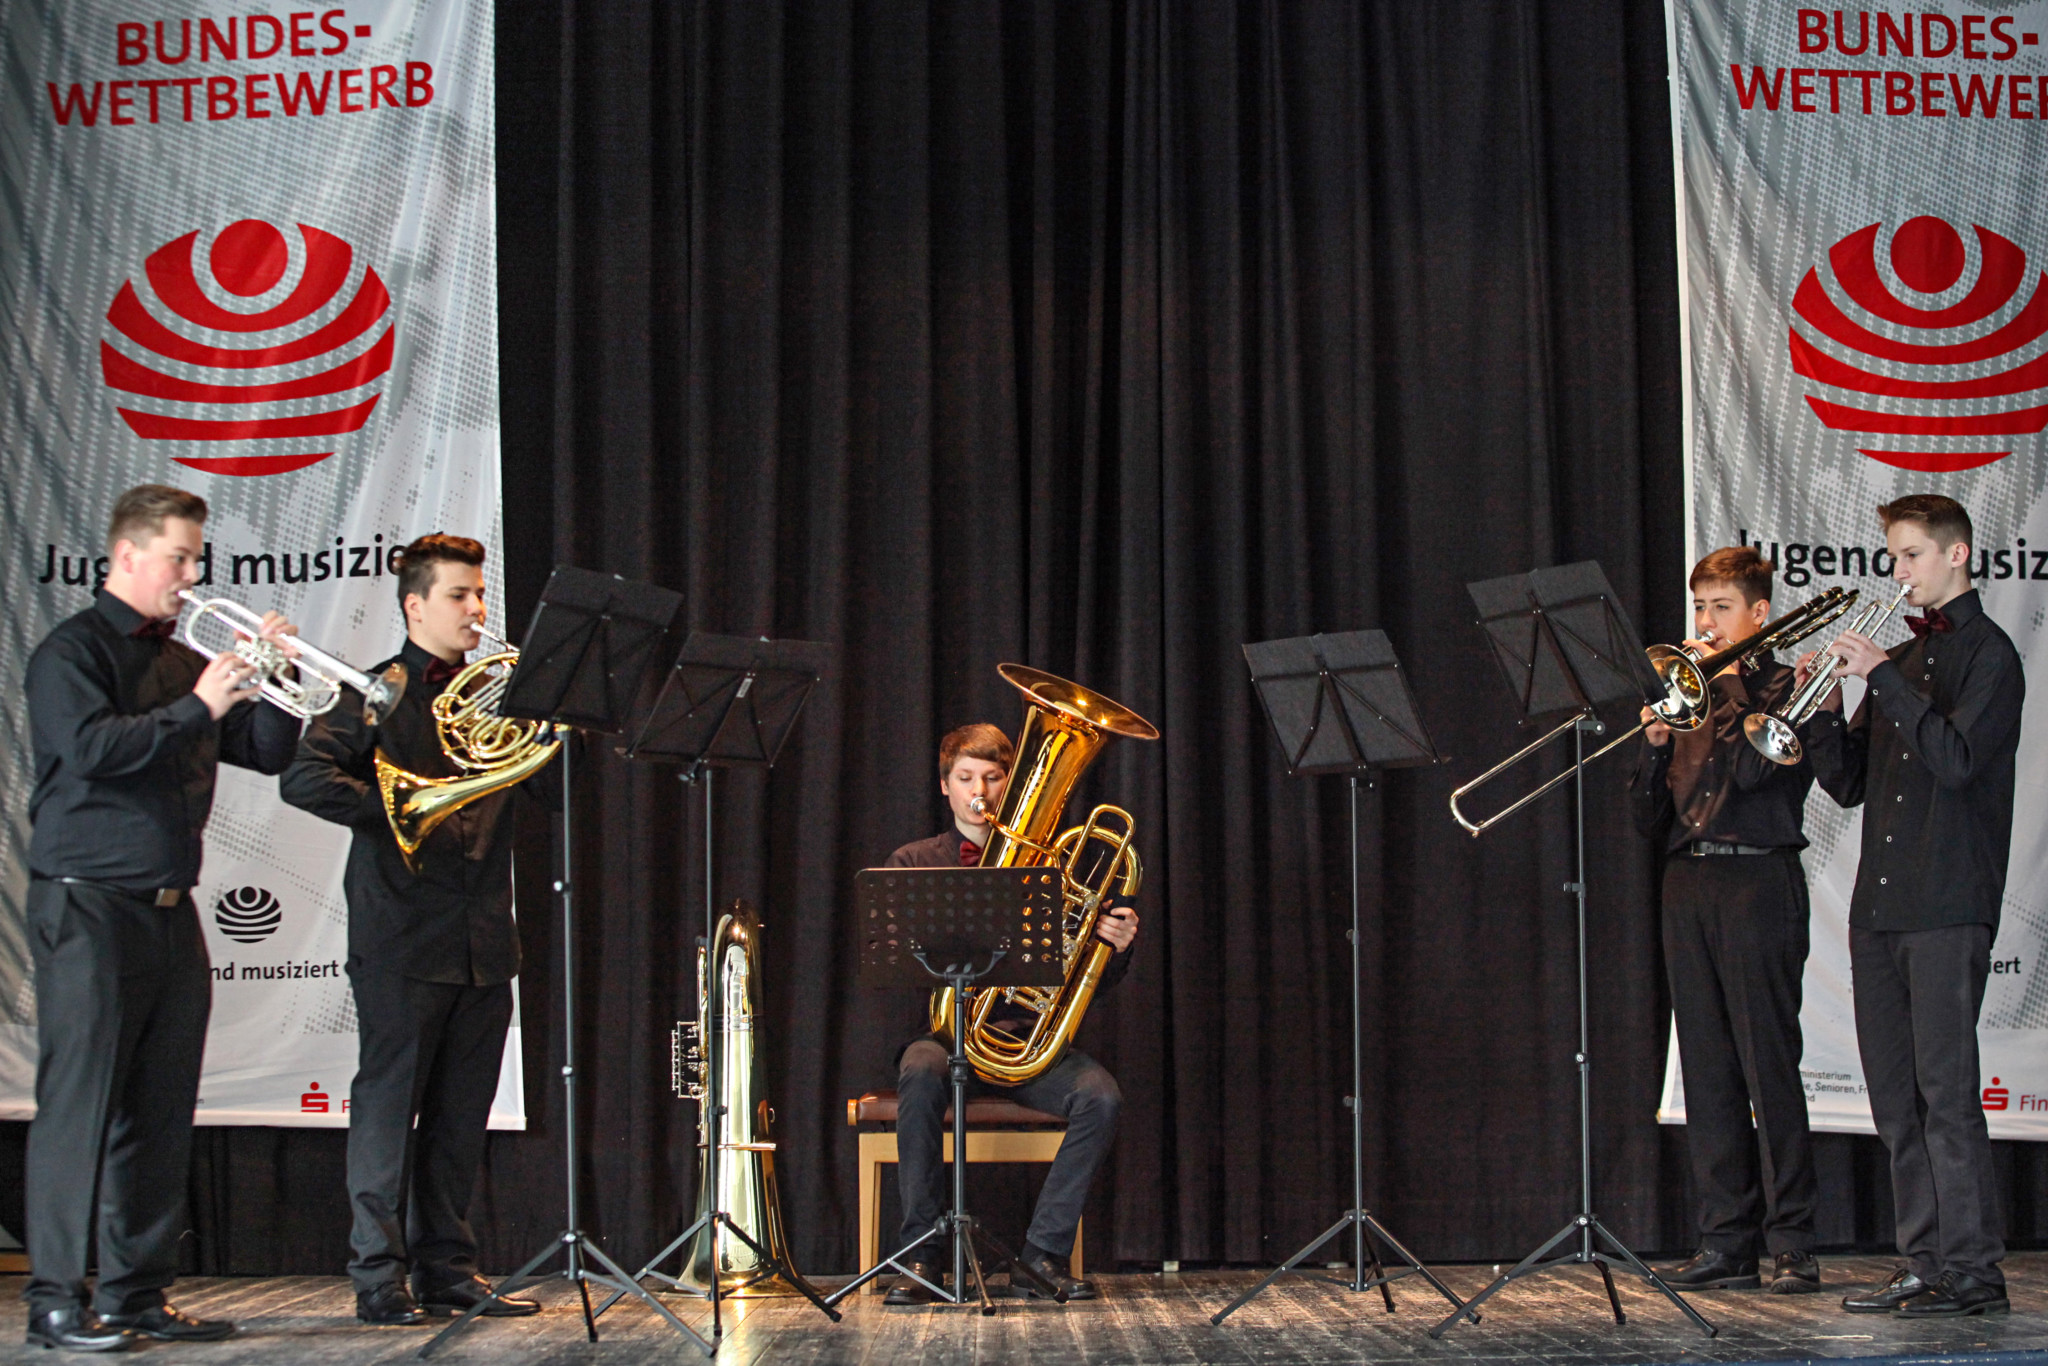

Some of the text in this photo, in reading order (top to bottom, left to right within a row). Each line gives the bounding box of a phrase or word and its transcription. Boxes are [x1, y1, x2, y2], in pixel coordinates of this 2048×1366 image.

[117, 9, 372, 66] BUNDES-
[1797, 8, 2039, 61] BUNDES-
[47, 61, 435, 127] WETTBEWERB
[242, 960, 339, 980] musiziert
